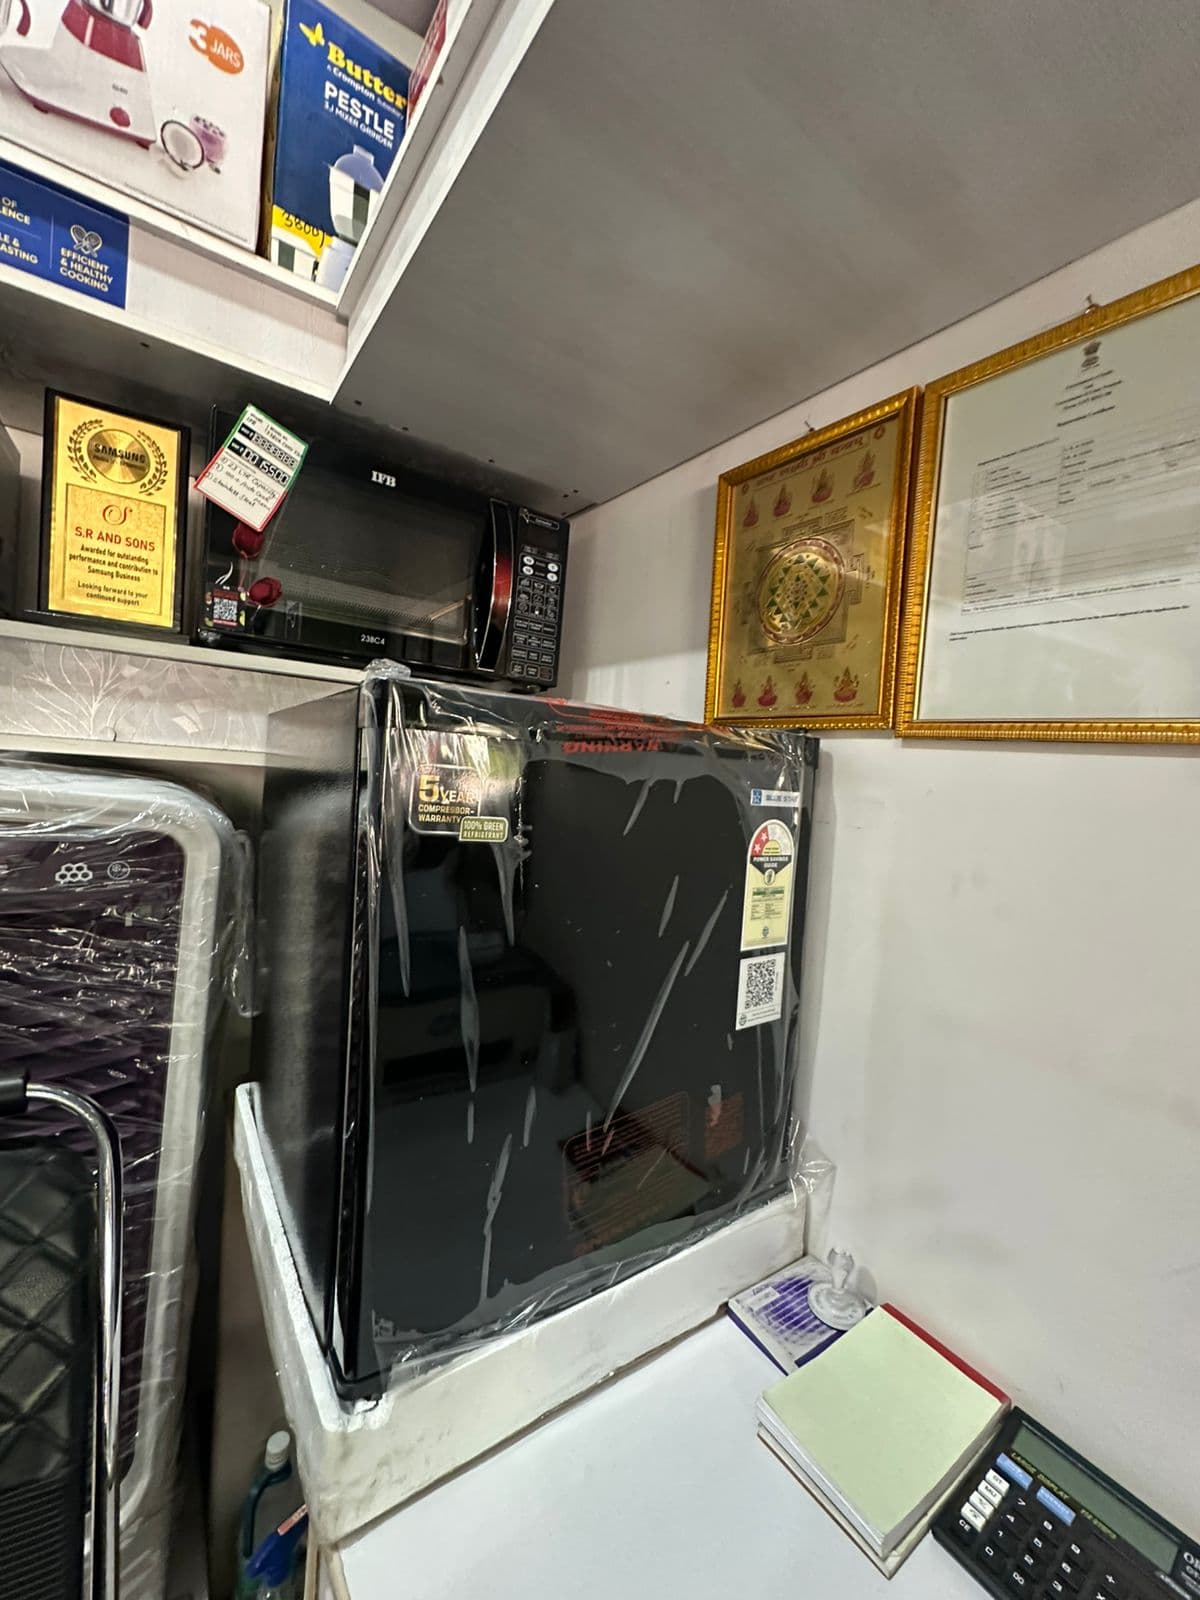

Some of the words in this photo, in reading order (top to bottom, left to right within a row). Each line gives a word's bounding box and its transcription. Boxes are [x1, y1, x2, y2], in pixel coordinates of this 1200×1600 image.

[211, 39, 241, 68] JARS
[325, 80, 395, 141] PESTLE
[335, 106, 359, 128] MIXER
[360, 123, 393, 149] GRINDER
[60, 247, 109, 273] EFFICIENT
[60, 257, 68, 266] &
[70, 260, 113, 284] HEALTHY
[60, 267, 108, 292] COOKING
[94, 443, 146, 464] SAMSUNG
[371, 470, 396, 488] IFB
[75, 526, 93, 539] S.R
[97, 531, 122, 545] AND
[125, 537, 155, 552] SONS
[80, 544, 106, 556] Awarded
[107, 549, 115, 558] for
[117, 552, 149, 566] outstanding
[69, 553, 106, 566] performance
[107, 560, 118, 569] and
[119, 562, 151, 574] contribution
[152, 568, 158, 576] to
[88, 565, 114, 579] Samsung
[116, 571, 141, 582] Business
[77, 580, 102, 592] Looking
[103, 585, 127, 596] forward
[128, 589, 134, 597] to
[86, 592, 115, 603] continued
[117, 597, 140, 606] support
[419, 774, 440, 802] 5
[418, 814, 461, 824] WARRANTY
[463, 820, 482, 830] 100%
[483, 821, 504, 831] GREEN
[463, 830, 504, 839] REFRIGERANT
[1011, 1453, 1037, 1474] LARGE
[1037, 1473, 1069, 1500] DISPLAY
[1017, 1498, 1026, 1506] 7
[959, 1519, 971, 1532] CE
[1005, 1514, 1016, 1524] 4
[997, 1530, 1004, 1538] 1
[1024, 1554, 1034, 1566] 2
[1052, 1580, 1063, 1592] 3
